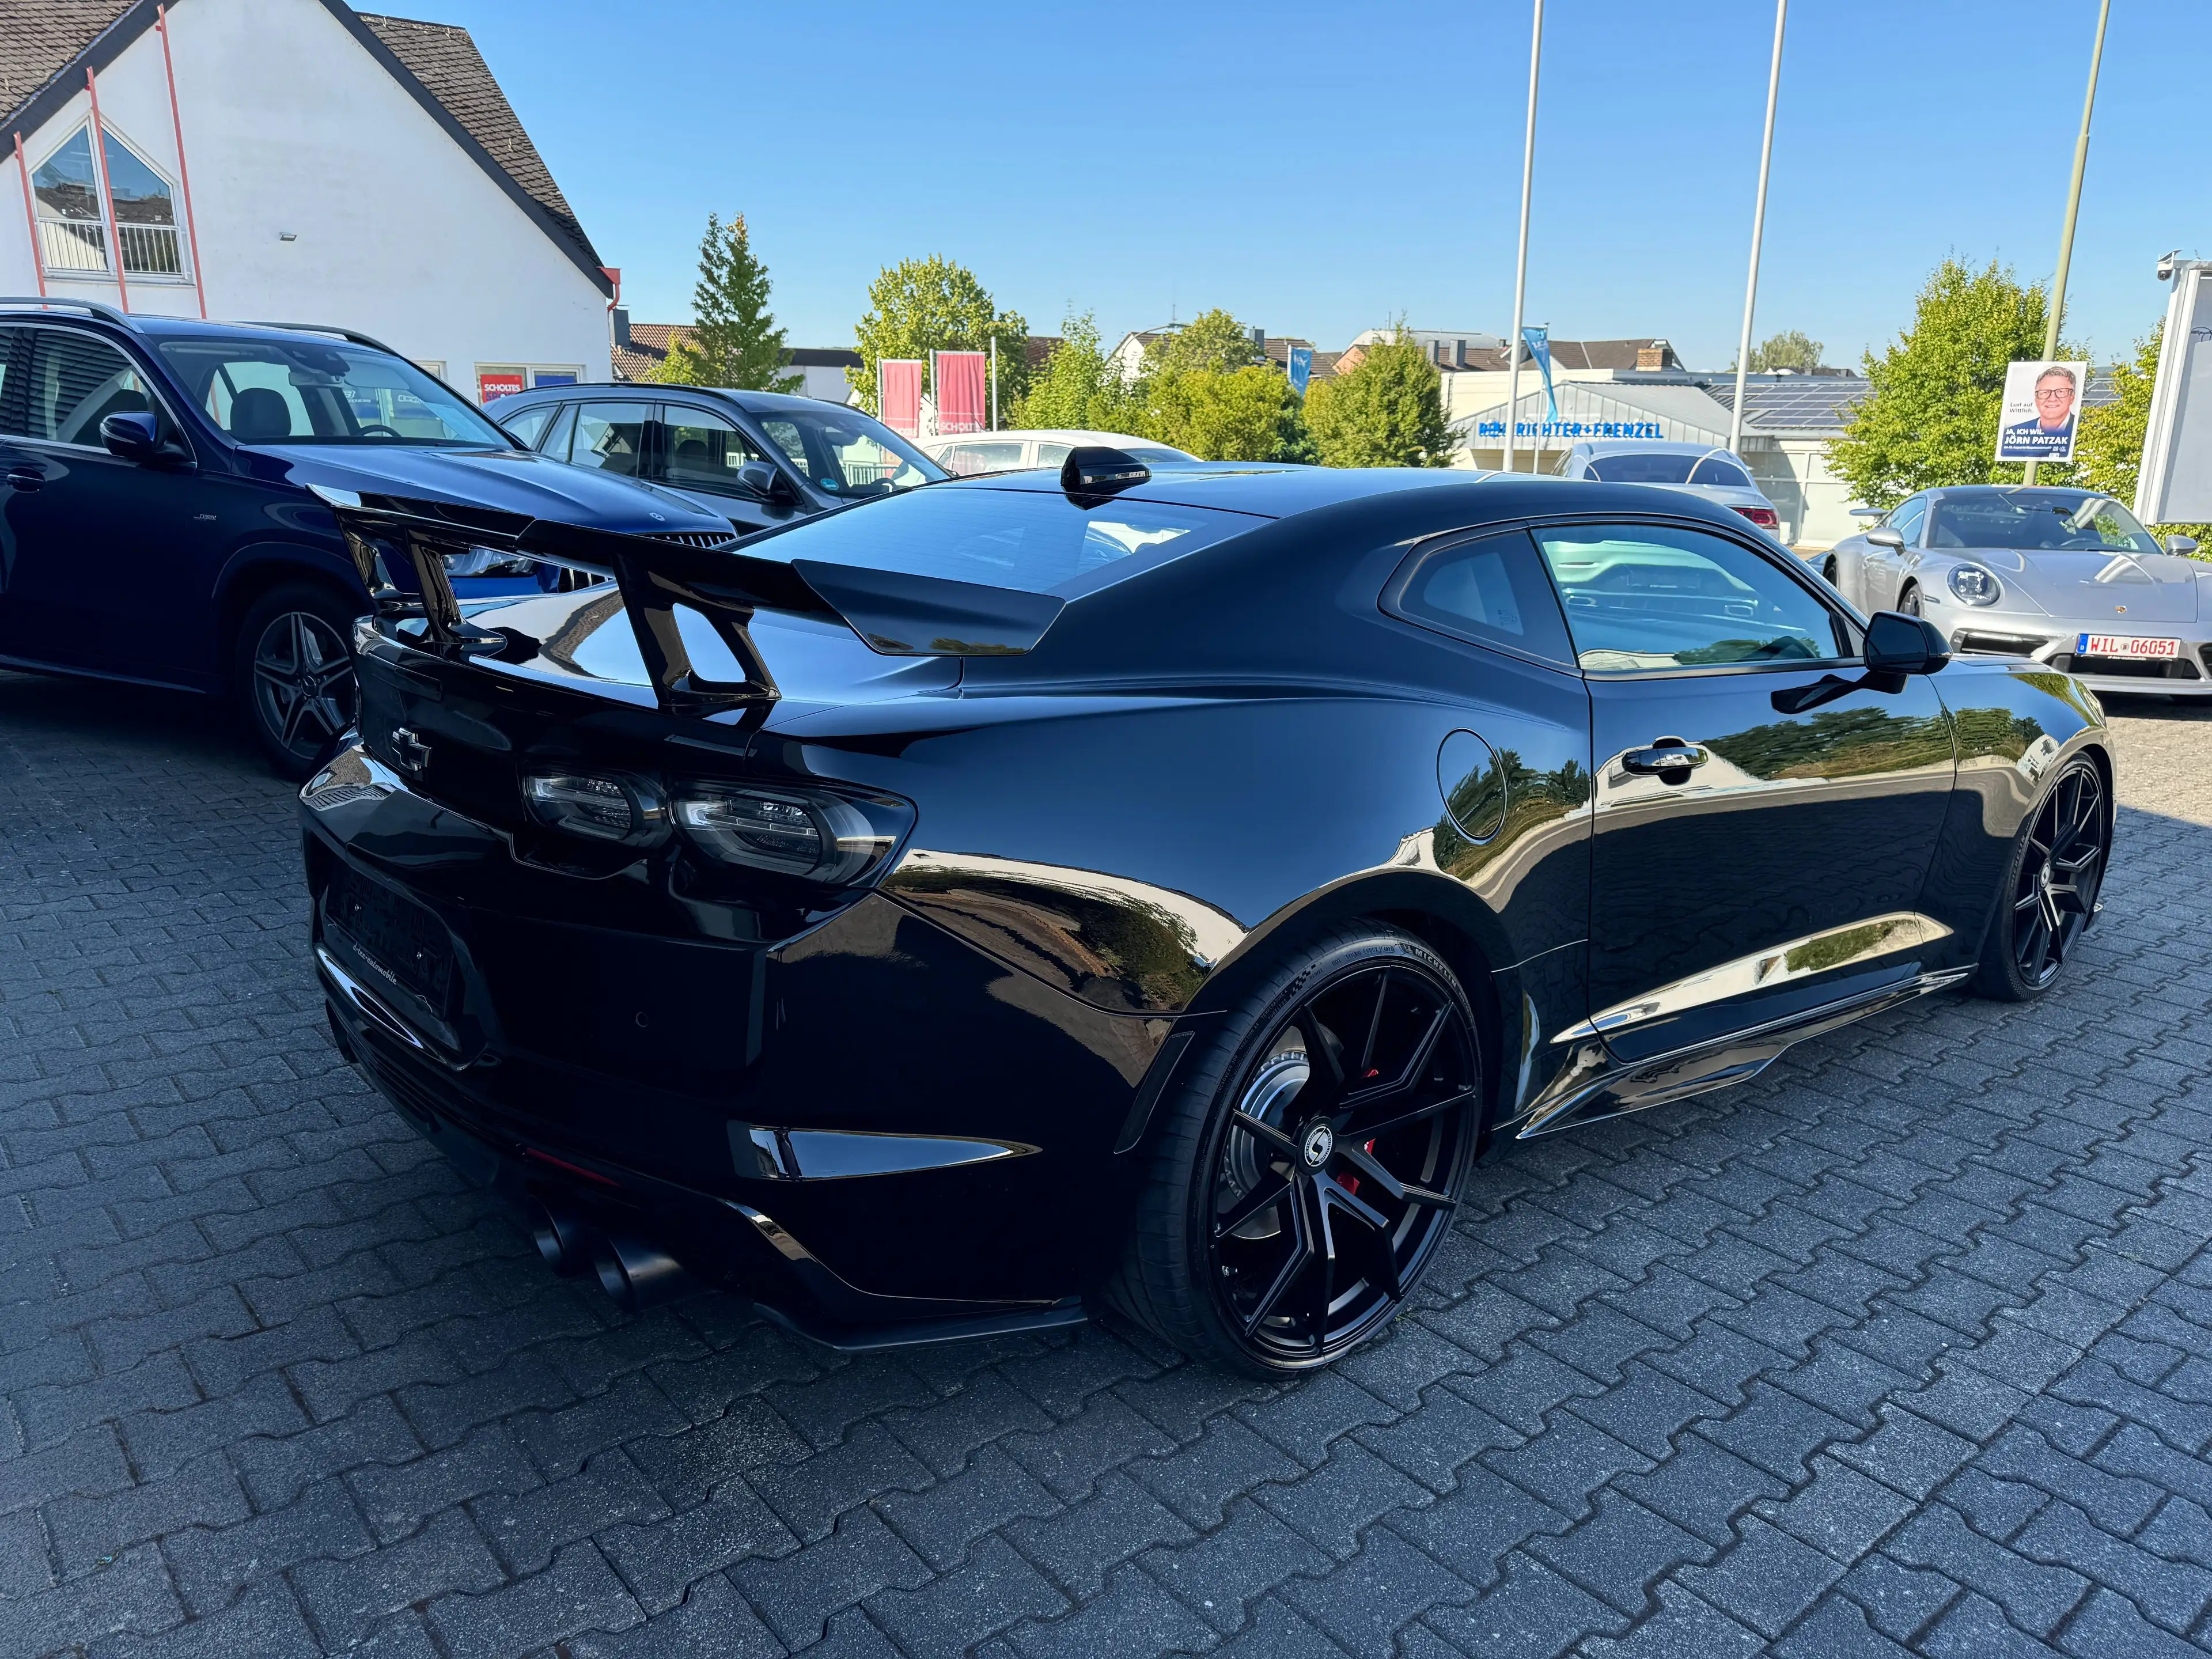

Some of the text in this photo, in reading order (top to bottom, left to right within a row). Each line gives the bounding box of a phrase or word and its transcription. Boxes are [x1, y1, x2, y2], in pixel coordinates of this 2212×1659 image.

[484, 384, 521, 392] SCHOLTES
[2005, 435, 2068, 444] JÖRN PATZAK
[2090, 637, 2118, 653] WIL
[2130, 640, 2175, 656] 06051
[1415, 948, 1457, 987] MICHELIN
[1267, 999, 1287, 1020] TUBELESS
[1217, 1064, 1233, 1093] TREADWEAR
[1239, 1028, 1255, 1051] TRACTION
